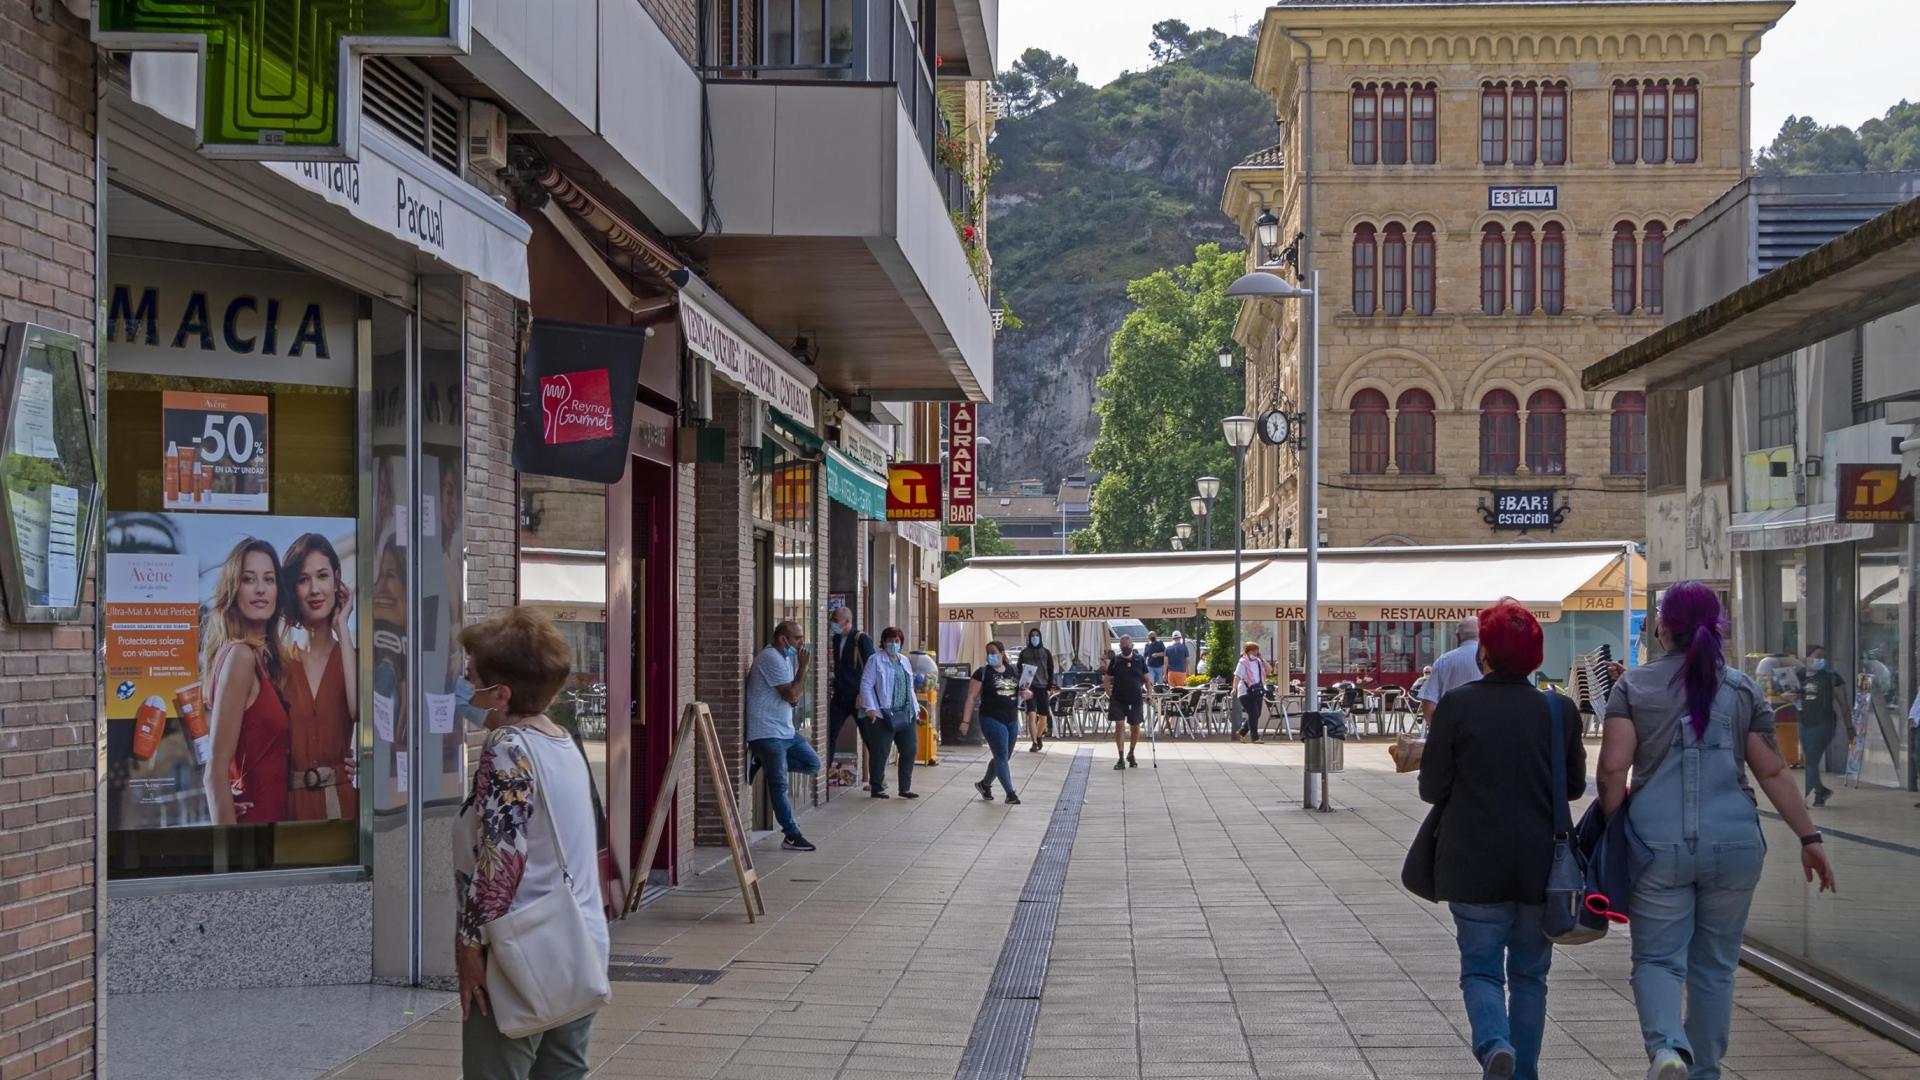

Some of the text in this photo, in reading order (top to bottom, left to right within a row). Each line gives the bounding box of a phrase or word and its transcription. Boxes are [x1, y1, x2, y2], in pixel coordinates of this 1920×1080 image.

[295, 162, 360, 206] armacia
[1493, 191, 1551, 205] ESTELLA
[571, 399, 605, 415] Reyno
[559, 405, 614, 431] Gourmet
[1505, 495, 1542, 511] BAR
[887, 508, 936, 519] ABACOS
[950, 504, 974, 522] BAR
[130, 567, 172, 583] Avène
[153, 606, 169, 617] Mat
[170, 606, 196, 617] Perfect
[949, 609, 974, 620] BAR
[1039, 606, 1131, 619] RESTAURANTE
[1161, 607, 1187, 616] AMSTEL
[1215, 609, 1235, 617] AMST
[1275, 607, 1304, 619] BAR
[117, 635, 185, 646] Protectores solares
[122, 649, 137, 657] con
[138, 648, 169, 657] vitamina
